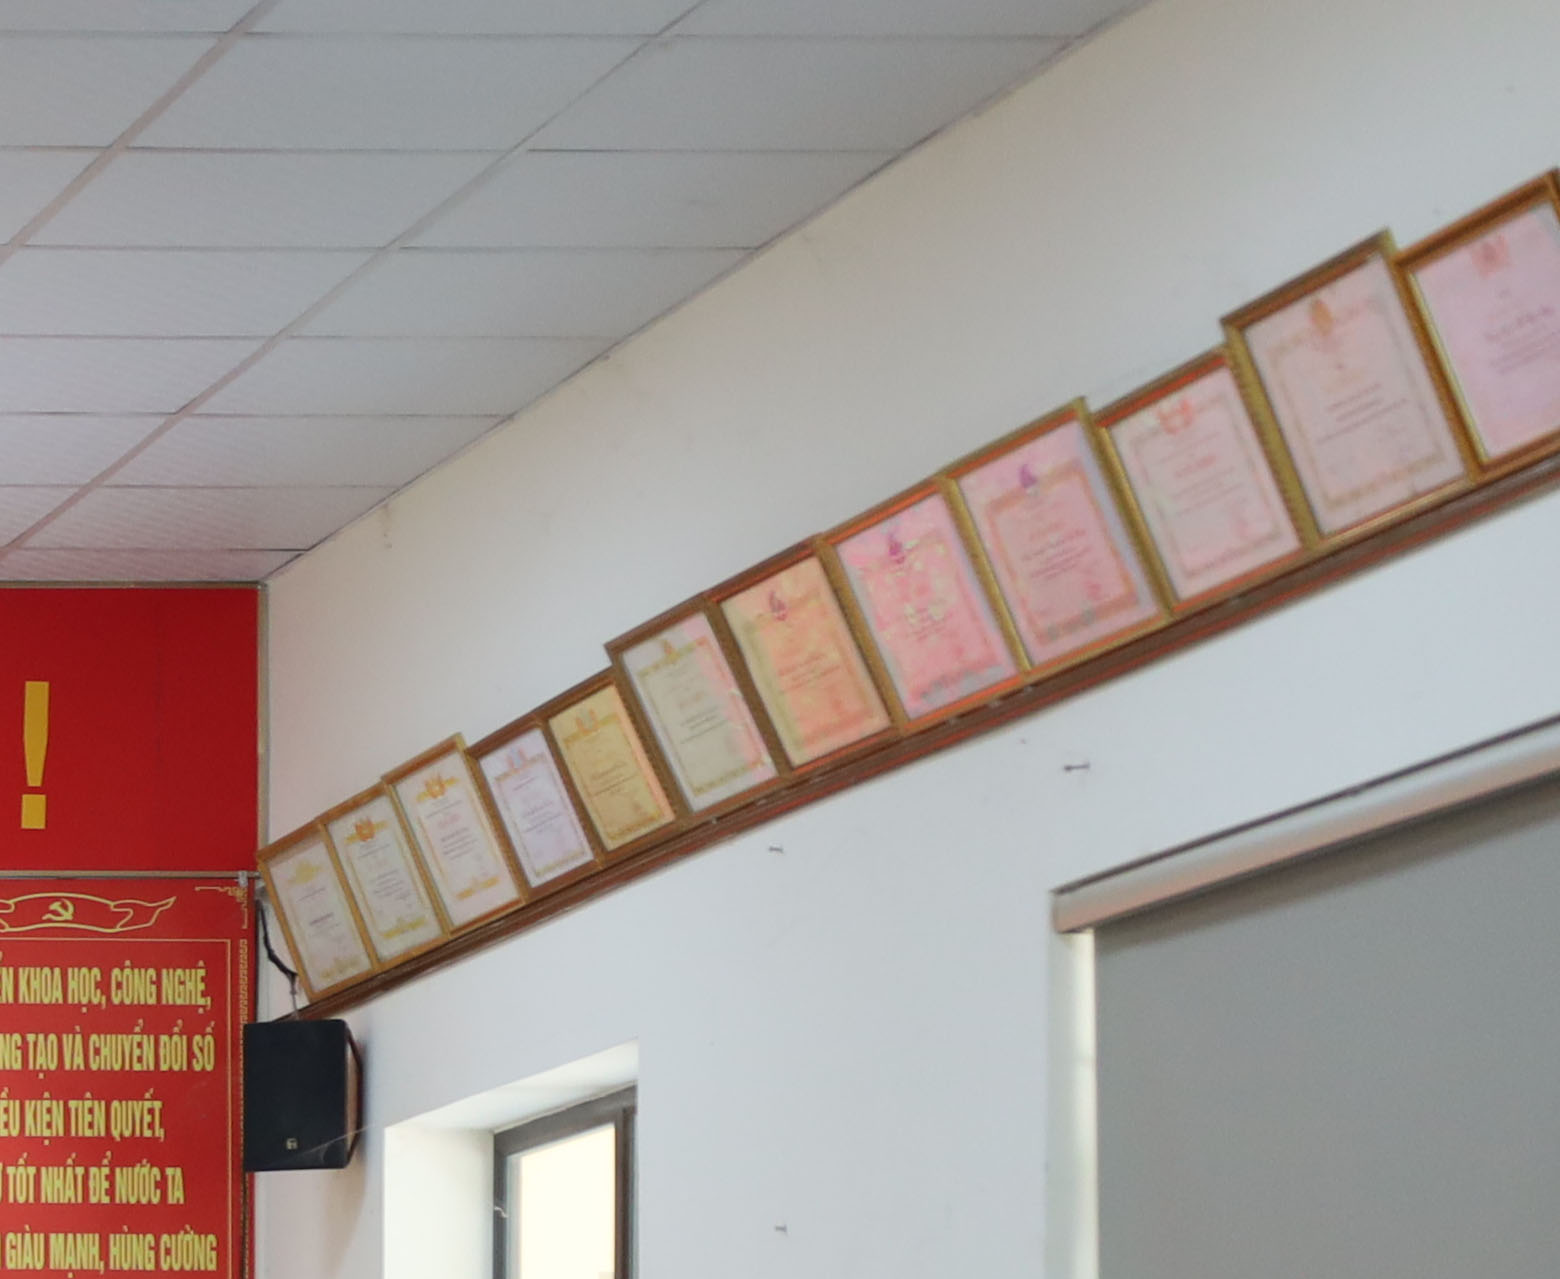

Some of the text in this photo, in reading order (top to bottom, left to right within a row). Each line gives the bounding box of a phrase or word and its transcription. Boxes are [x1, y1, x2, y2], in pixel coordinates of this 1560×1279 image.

[21, 681, 49, 829] !
[19, 967, 63, 1004] KHOA
[68, 968, 105, 1012] HỌC,
[112, 960, 156, 1004] CÔNG
[162, 962, 210, 1013] NGHỆ,
[25, 1092, 64, 1145] KIỆN
[69, 1092, 105, 1136] TIÊN
[111, 1089, 164, 1140] QUYẾT,
